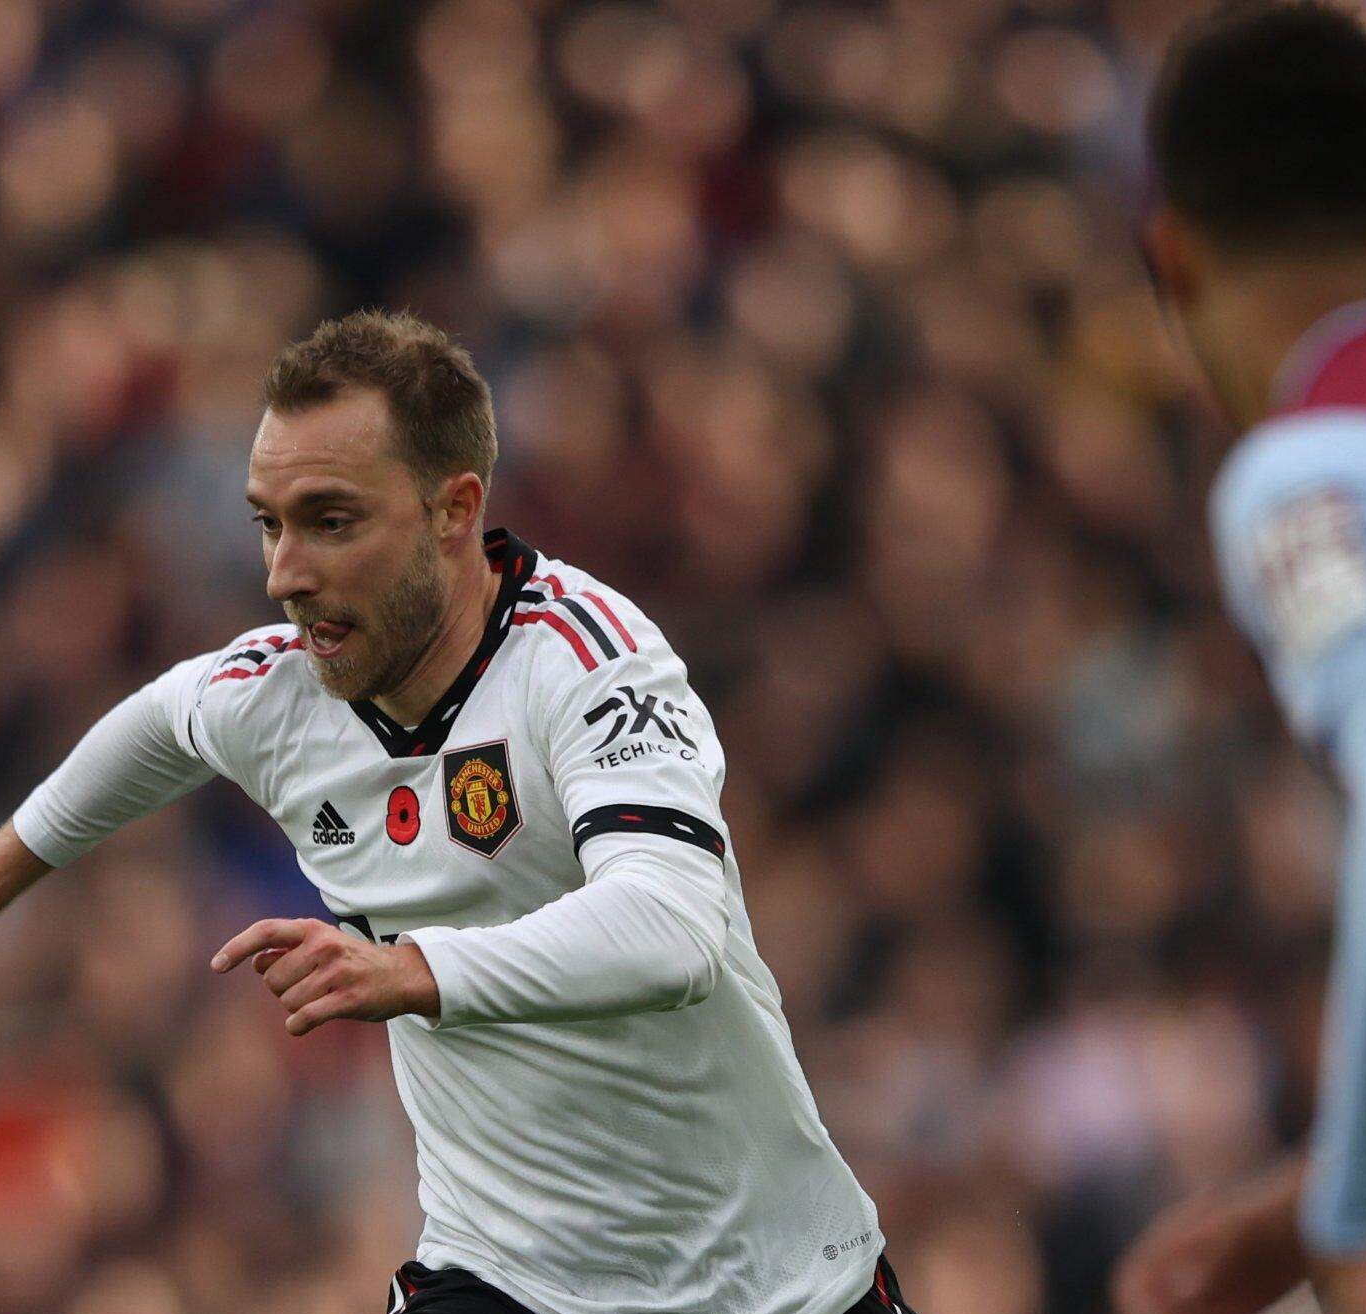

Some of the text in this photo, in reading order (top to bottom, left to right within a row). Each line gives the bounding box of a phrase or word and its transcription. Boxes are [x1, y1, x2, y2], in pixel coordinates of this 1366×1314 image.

[455, 764, 499, 793] MANCHESTER
[467, 817, 501, 834] UNITED
[313, 828, 355, 845] adidas
